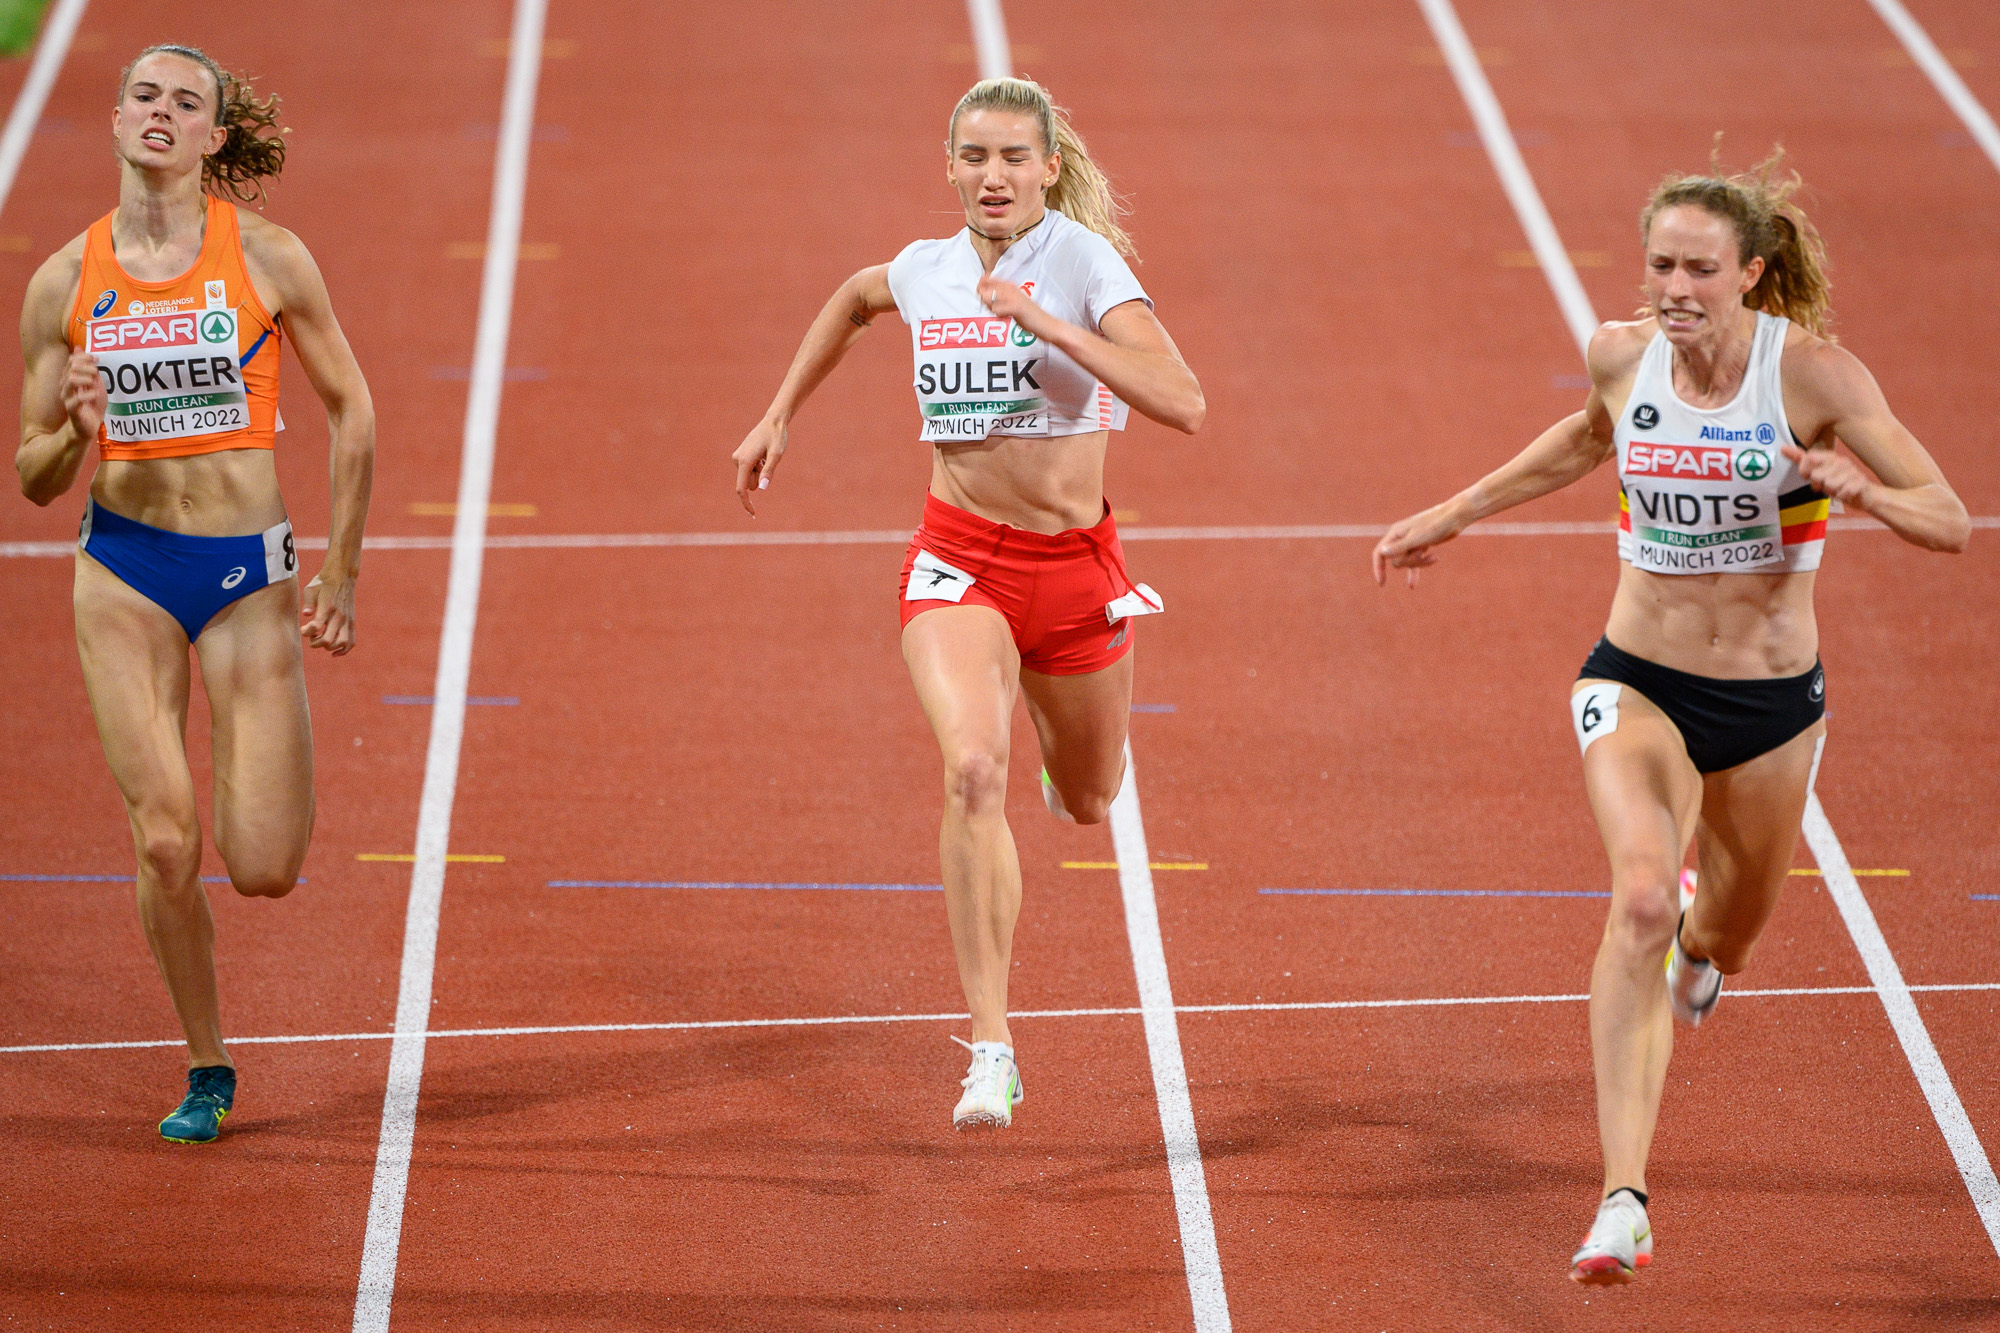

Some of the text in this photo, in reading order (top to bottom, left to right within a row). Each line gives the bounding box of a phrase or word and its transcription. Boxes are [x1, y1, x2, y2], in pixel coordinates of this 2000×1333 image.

[145, 306, 178, 314] LOTERIJ
[146, 297, 195, 308] NEDERLANDSE
[94, 317, 195, 348] SPAR
[922, 321, 1008, 347] SPAR
[919, 359, 1041, 395] SULEK
[128, 403, 133, 414] I
[136, 401, 164, 412] RUN
[949, 404, 972, 414] RUN
[110, 408, 241, 436] MUNICH 2022
[926, 414, 1038, 435] MUNICH 2022
[1699, 425, 1752, 441] Allianz
[1629, 447, 1730, 476] SPAR
[1635, 489, 1761, 526] VIDTS
[282, 531, 296, 572] 8
[1667, 532, 1692, 546] RUN
[1641, 542, 1773, 569] MUNICH 2022
[1582, 694, 1602, 733] 6
